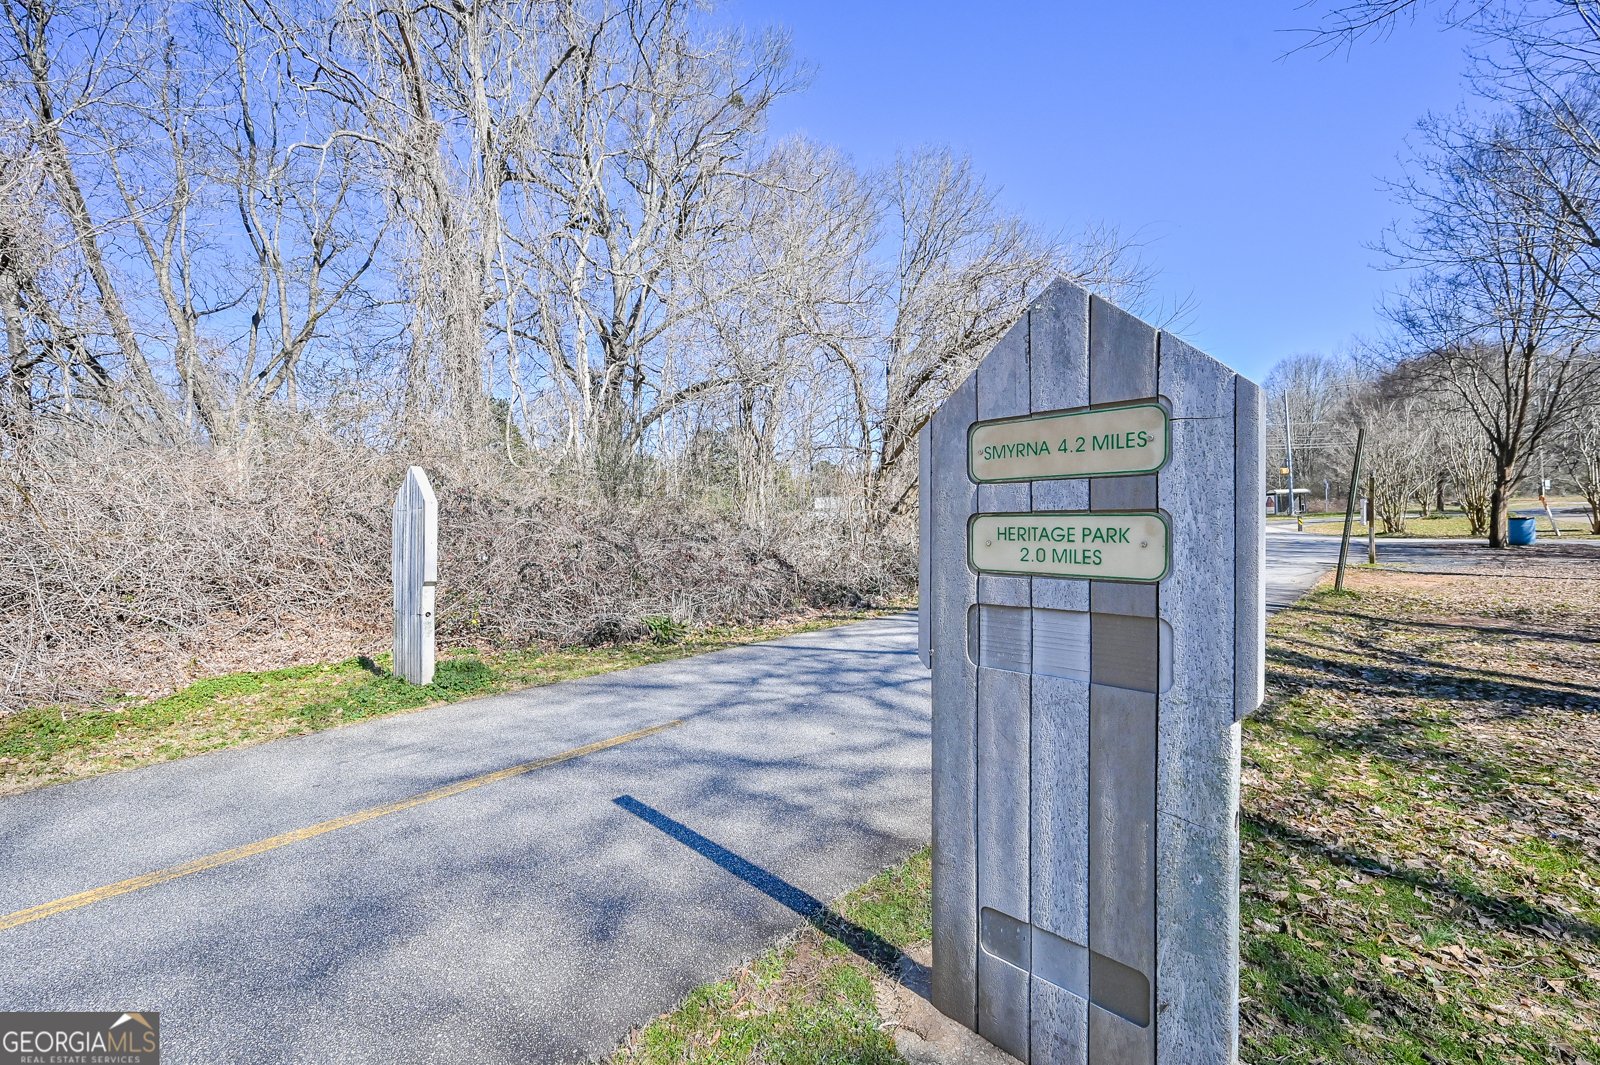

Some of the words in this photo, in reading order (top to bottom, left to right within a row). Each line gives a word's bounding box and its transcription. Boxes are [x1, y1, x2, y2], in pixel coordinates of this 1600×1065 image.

[984, 441, 1050, 460] SMYRNA
[1058, 437, 1086, 453] 4.2
[1092, 431, 1148, 451] MILES
[997, 526, 1076, 543] HERITAGE
[1081, 527, 1131, 544] PARK
[1020, 547, 1046, 563] 2.0
[1052, 548, 1102, 565] MILES
